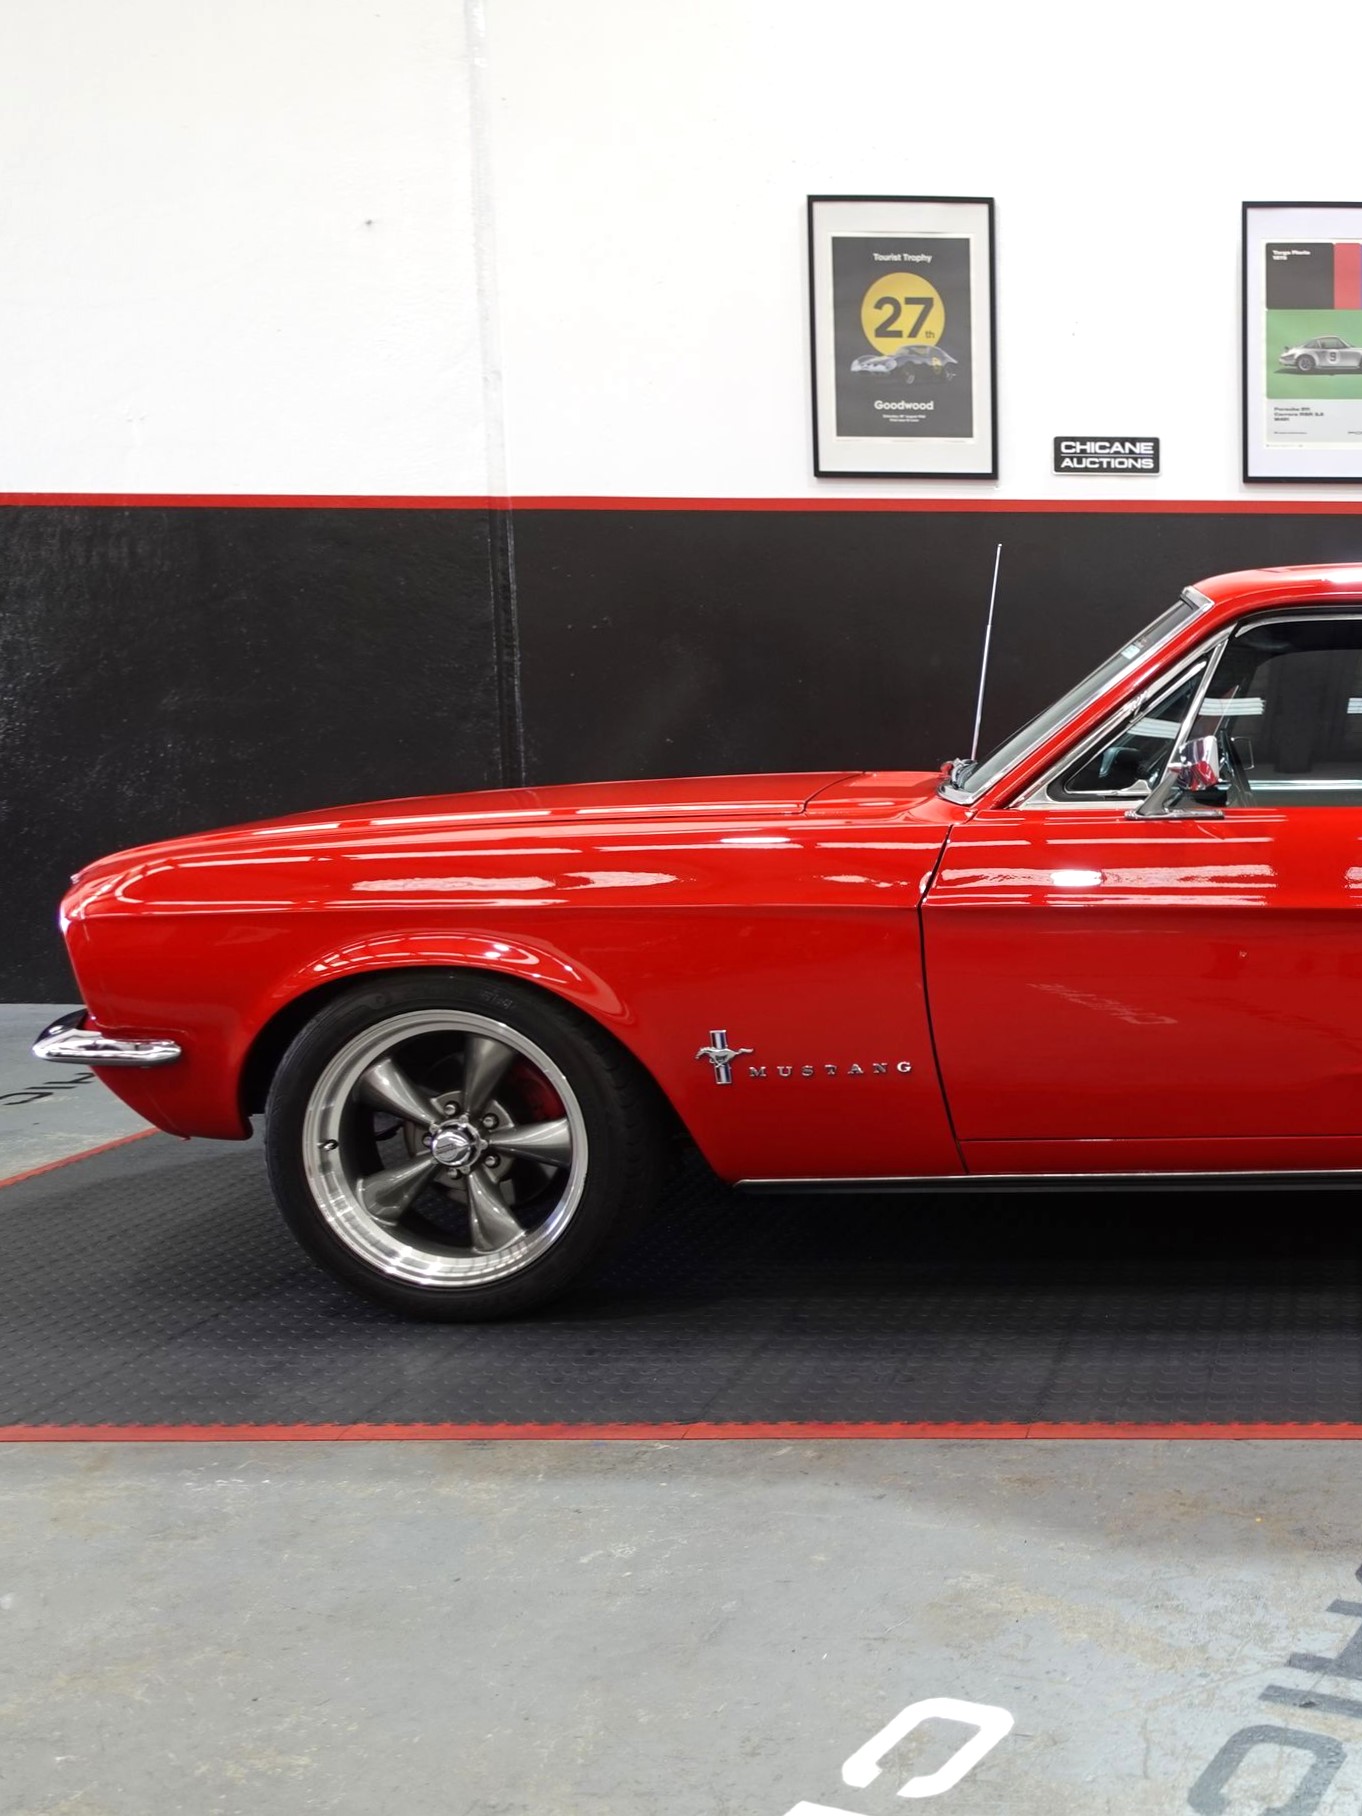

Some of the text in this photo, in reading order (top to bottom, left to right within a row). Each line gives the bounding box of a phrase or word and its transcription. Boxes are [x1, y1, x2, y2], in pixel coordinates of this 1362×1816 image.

[873, 253, 932, 263] Tourist Trophy
[874, 400, 934, 410] Goodwood
[1061, 441, 1154, 454] CHICANE
[1061, 458, 1154, 469] AUCTIONS
[749, 1061, 912, 1077] MUSTANG
